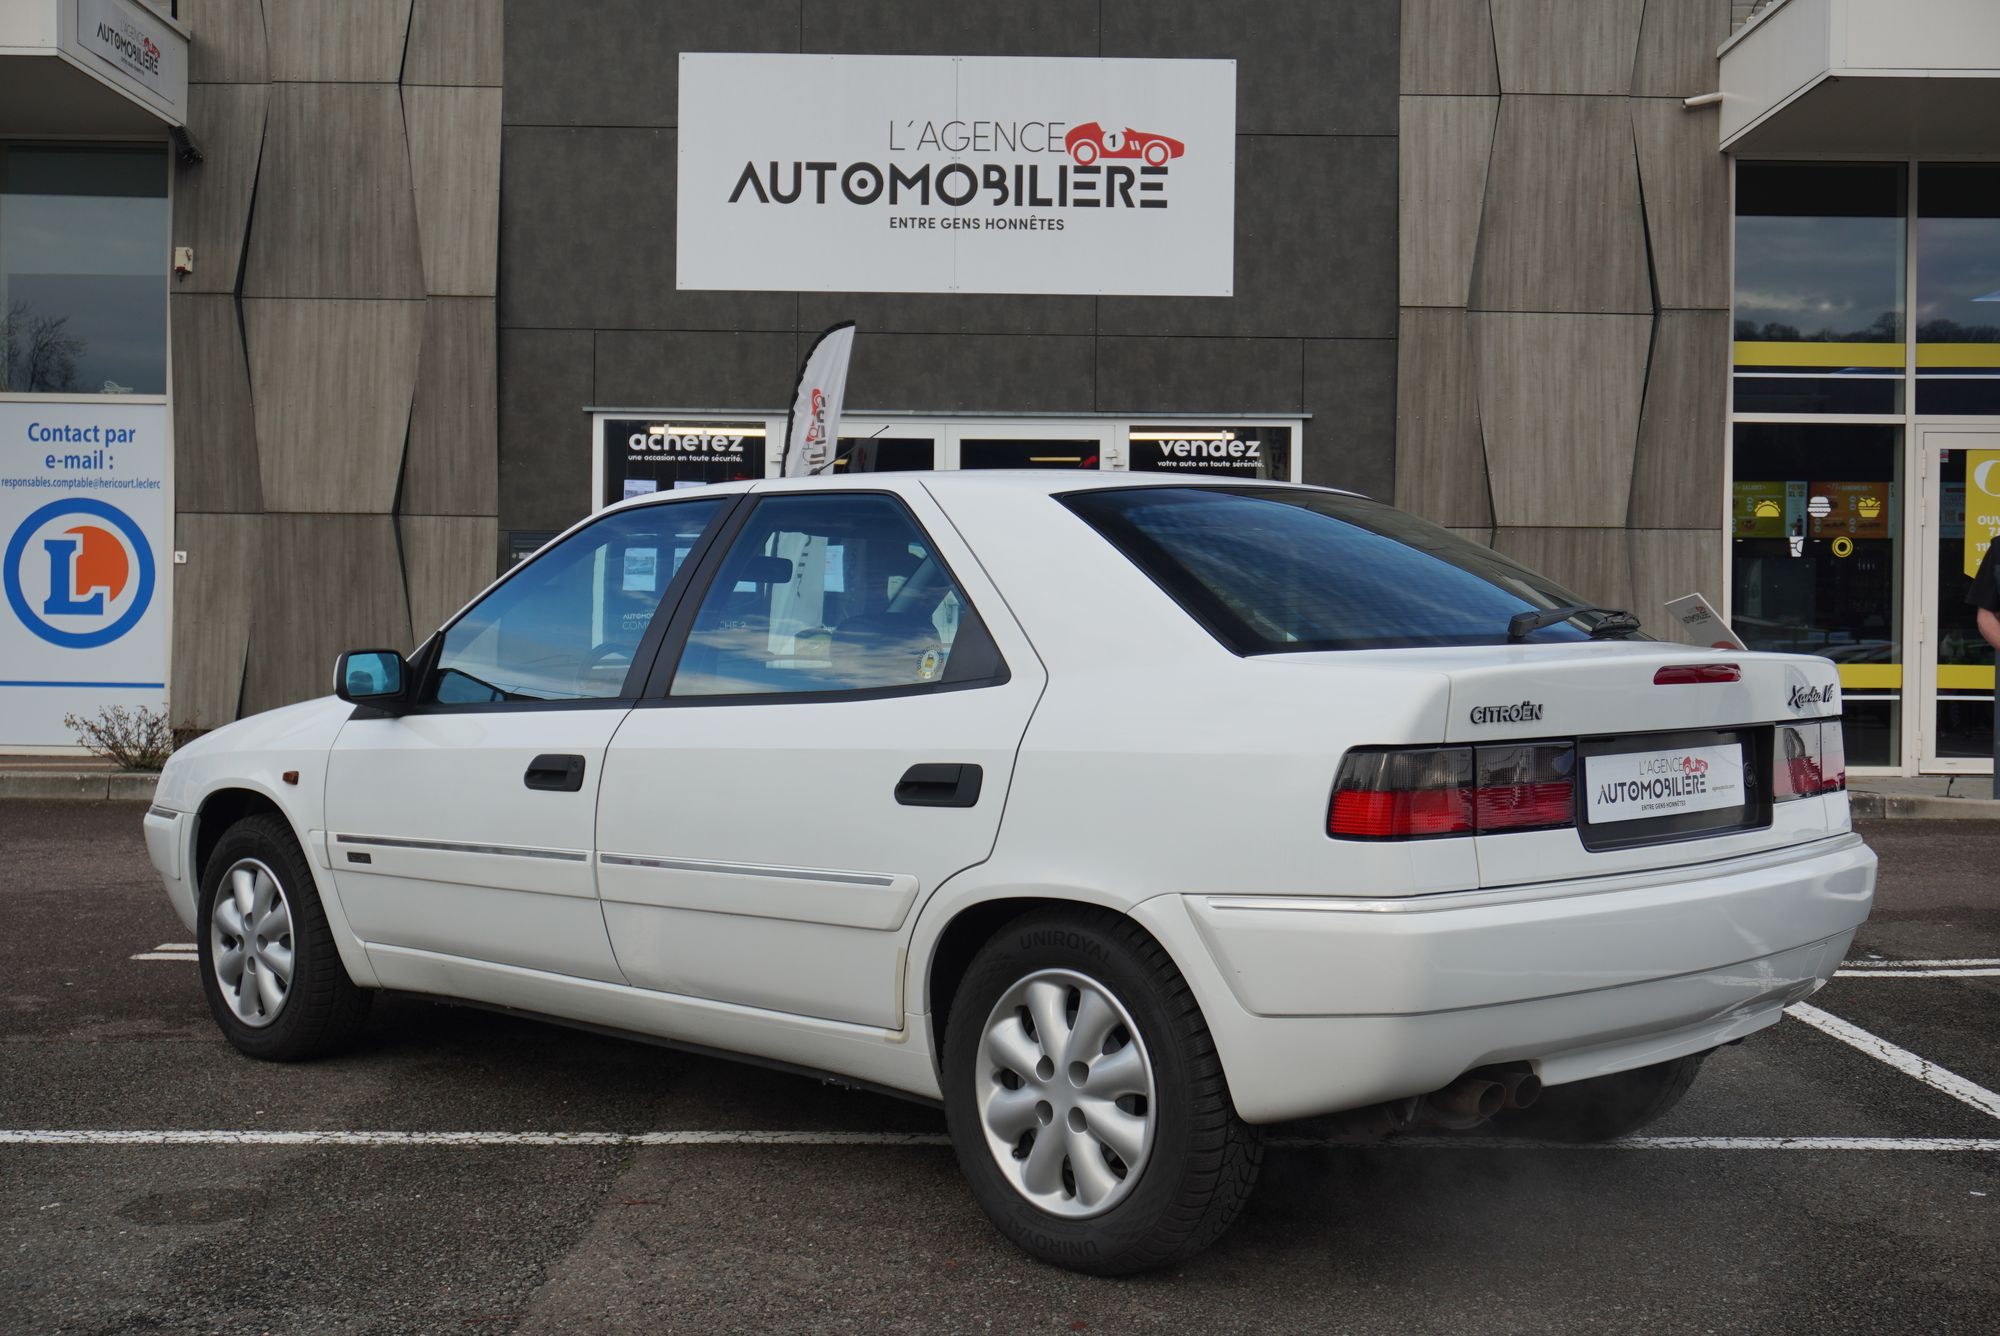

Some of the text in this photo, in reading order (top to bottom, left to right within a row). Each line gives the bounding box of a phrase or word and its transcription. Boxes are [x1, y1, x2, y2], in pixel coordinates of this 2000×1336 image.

[889, 119, 1066, 152] L'AGENCE
[889, 214, 1065, 231] ENTRE GENS HONNÊTES
[28, 422, 136, 448] Contact par
[628, 423, 744, 452] achetez
[1158, 430, 1261, 457] vendez
[45, 450, 103, 469] e-mail
[644, 453, 676, 461] occasion
[689, 453, 709, 462] toute
[711, 453, 743, 463] sécurité.
[1232, 459, 1264, 467] sérénité.
[1, 476, 160, 490] responsables.comptable@hericourt.leclerc
[1470, 700, 1543, 724] CITROËN
[1638, 757, 1684, 775] L'AGENCE
[1641, 803, 1654, 811] ENTRE
[1655, 802, 1666, 810] GENS
[1020, 930, 1111, 969] UNIROYAL
